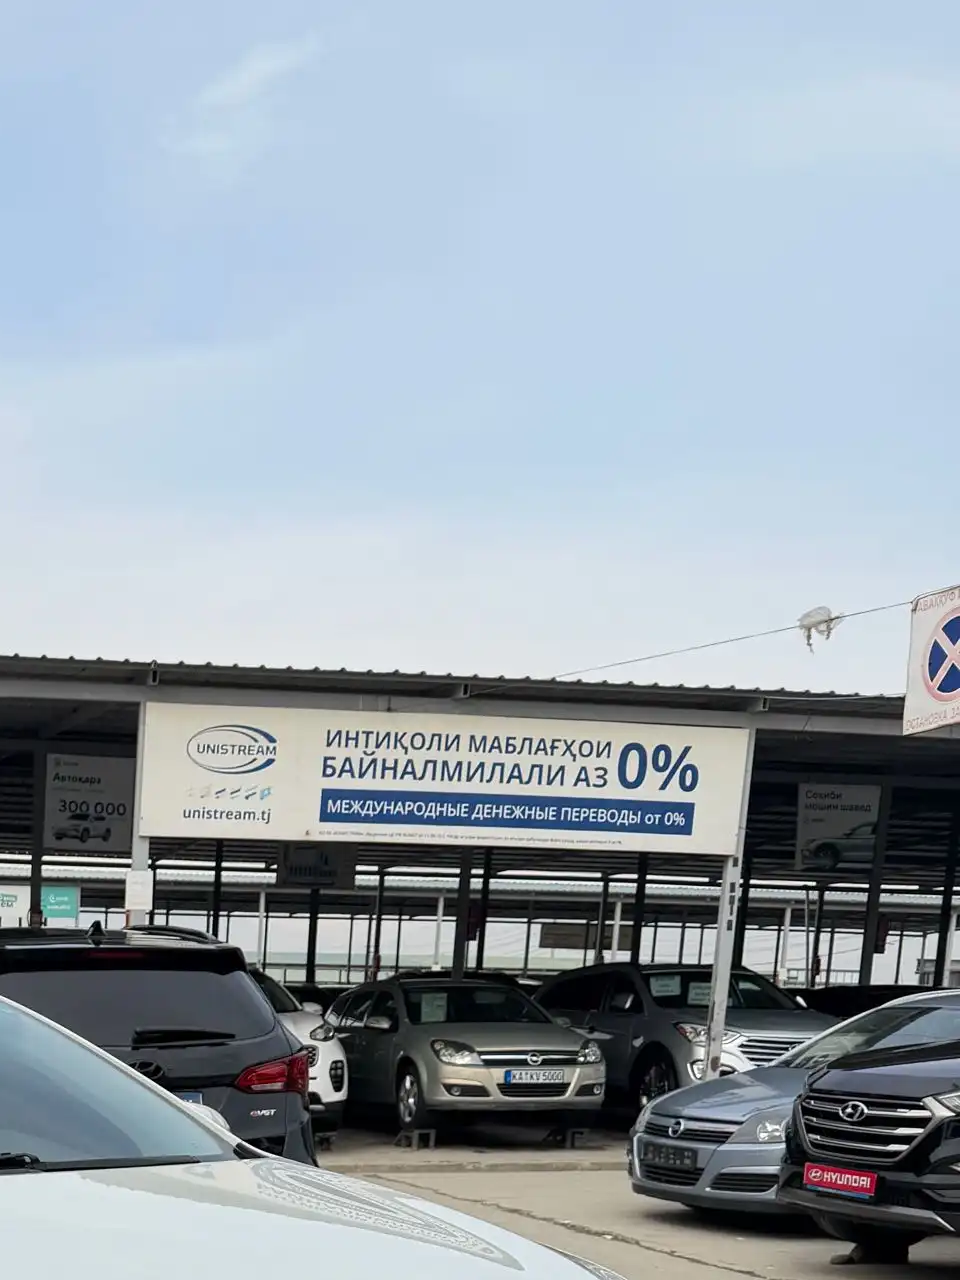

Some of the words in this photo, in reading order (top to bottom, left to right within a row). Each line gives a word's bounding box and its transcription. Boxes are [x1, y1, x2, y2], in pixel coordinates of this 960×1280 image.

[196, 743, 277, 756] UNISTREAM
[325, 729, 461, 755] ИНТИҚОЛИ
[468, 735, 613, 762] МАБЛАҒҲОИ
[321, 750, 566, 786] БАЙНАЛМИЛАЛИ
[573, 766, 609, 788] АЗ
[617, 742, 700, 793] 0%
[182, 806, 272, 824] unistream.tj
[326, 799, 469, 819] МЕЖДУНАРОДНЫЕ
[471, 804, 557, 821] ДЕНЕЖНЫЕ
[560, 807, 641, 826] ПЕРЕВОДЫ
[644, 813, 662, 825] от
[664, 811, 686, 826] 0%
[823, 1171, 872, 1189] HYUNDAI
